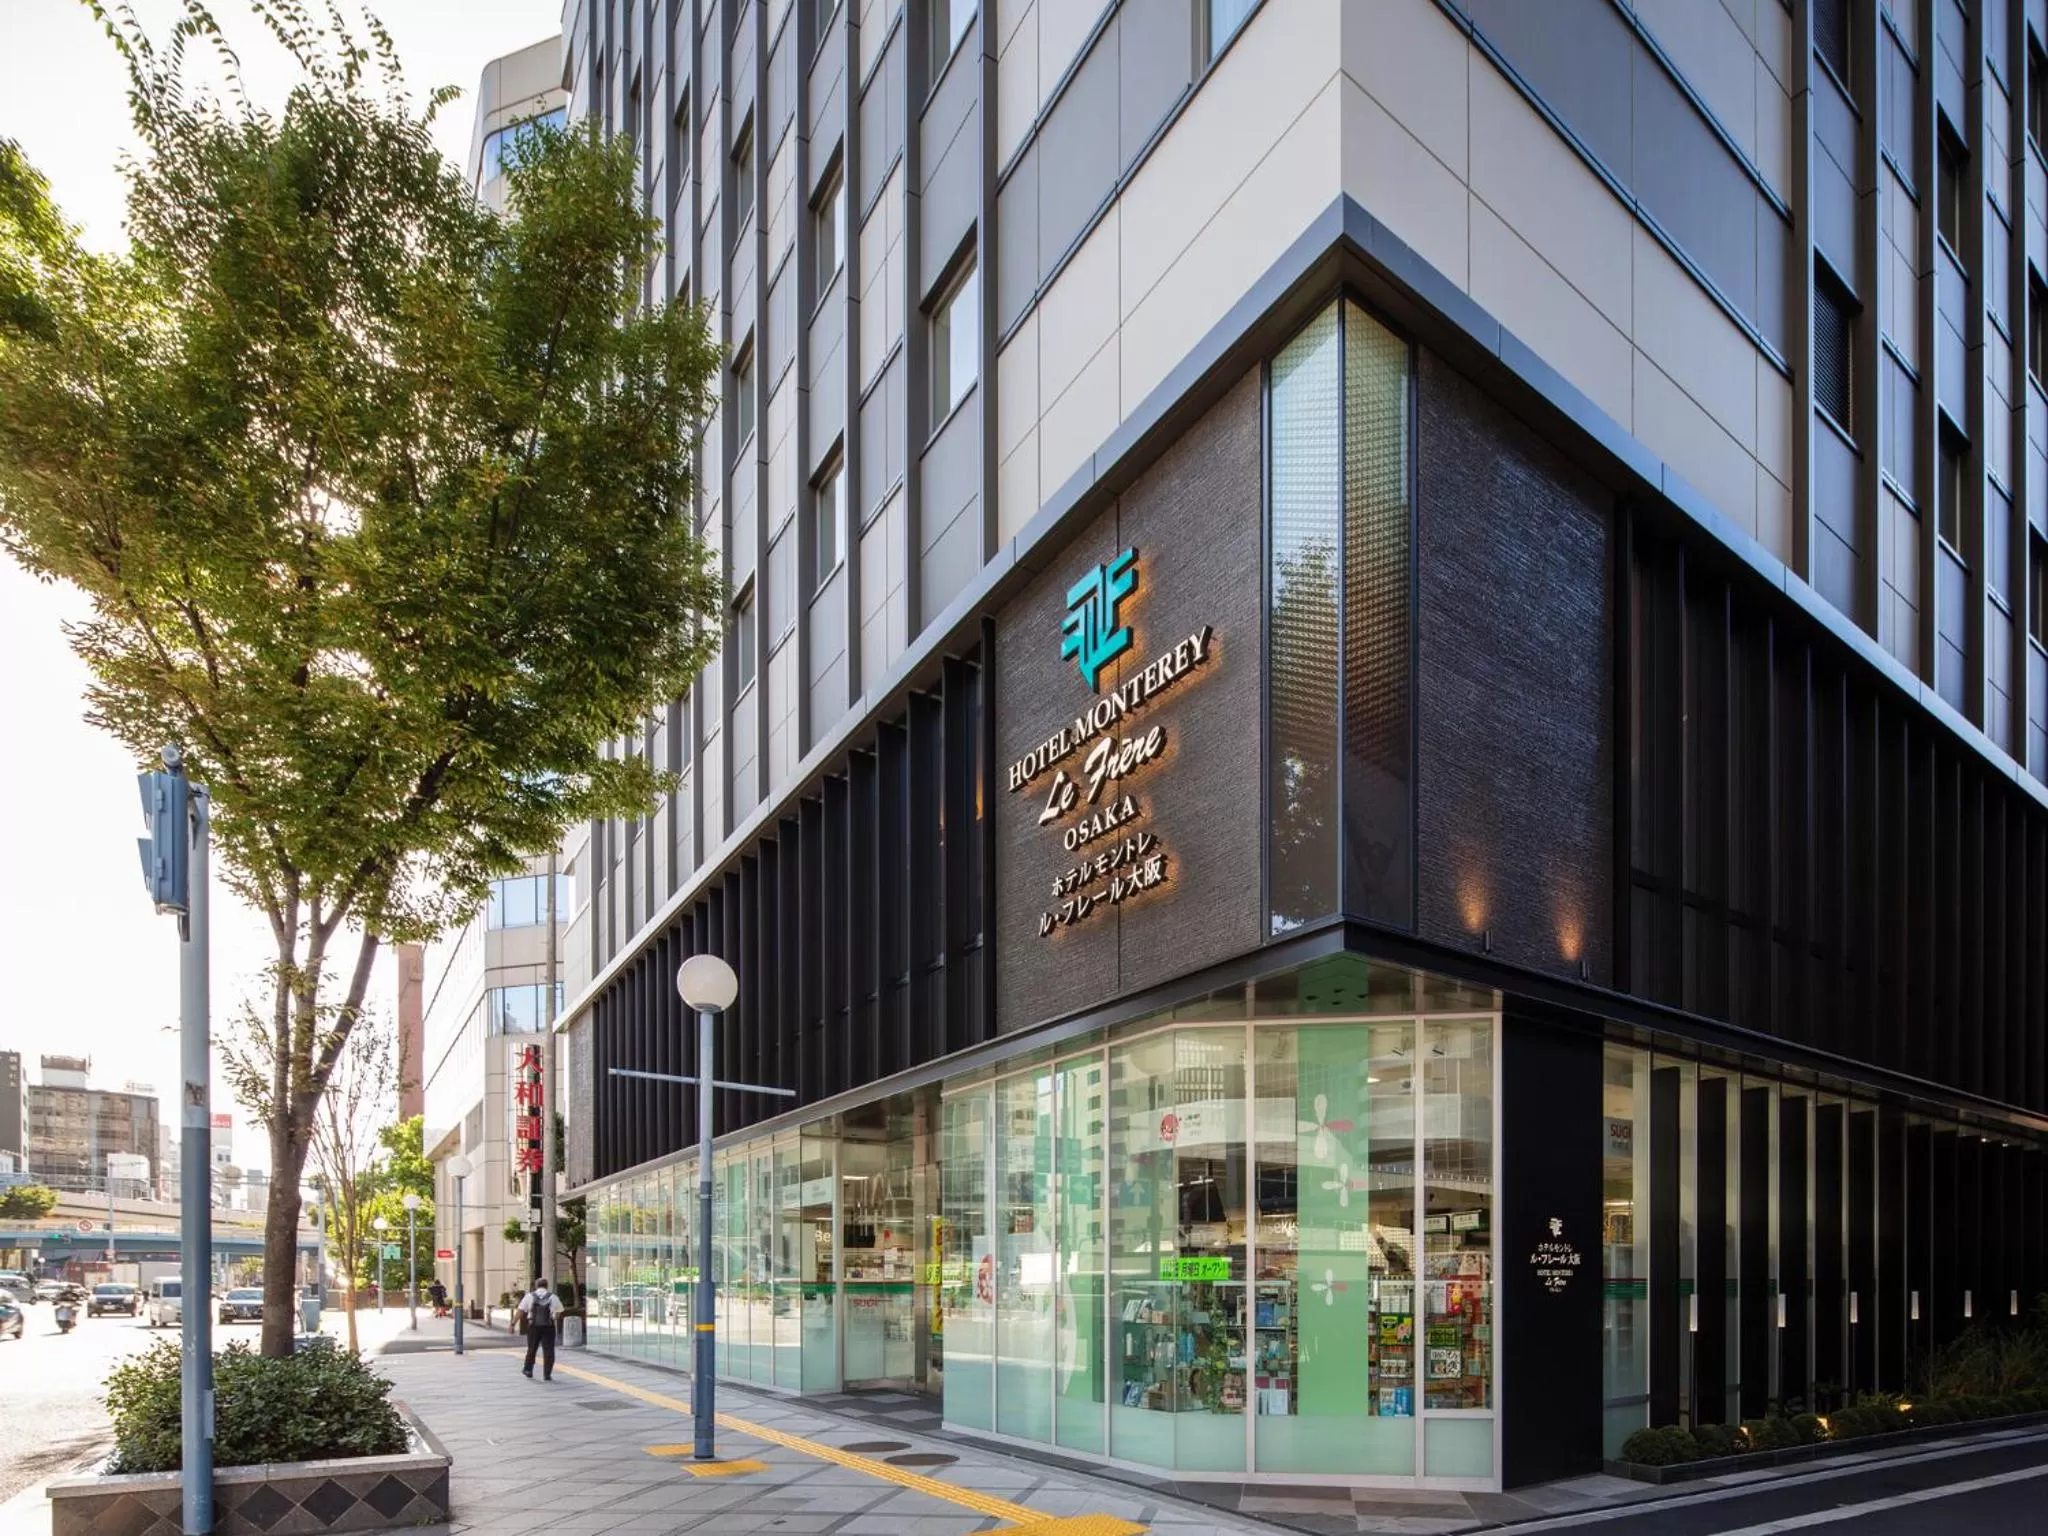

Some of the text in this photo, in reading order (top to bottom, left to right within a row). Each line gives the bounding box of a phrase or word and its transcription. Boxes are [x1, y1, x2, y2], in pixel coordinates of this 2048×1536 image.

[1008, 625, 1210, 790] HOTEL MONTEREY
[1038, 725, 1162, 825] Le Frère
[1052, 832, 1153, 897] ホテルモントレ
[1063, 795, 1136, 851] OSAKA
[1038, 853, 1163, 937] ル・フレール大阪
[514, 1047, 545, 1174] 大和証券
